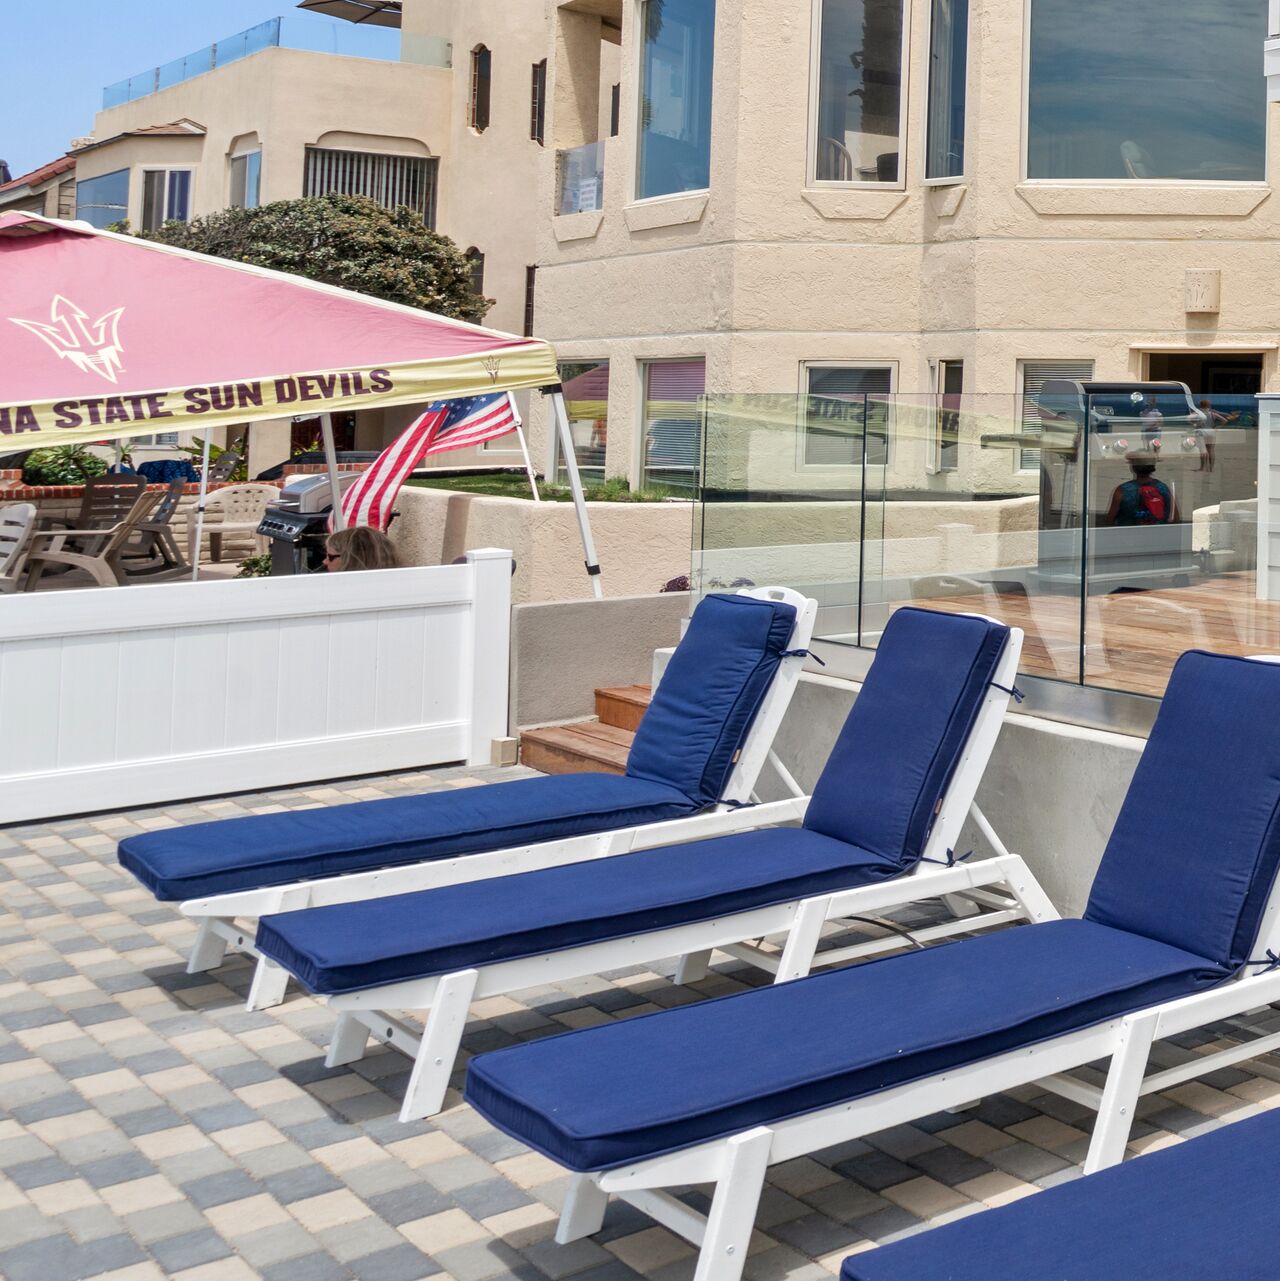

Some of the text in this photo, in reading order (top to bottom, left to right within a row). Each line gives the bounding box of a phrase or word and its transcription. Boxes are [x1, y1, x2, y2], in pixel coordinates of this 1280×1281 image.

[53, 392, 173, 428] STATE
[183, 381, 263, 414] SUN
[274, 368, 394, 404] DEVILS
